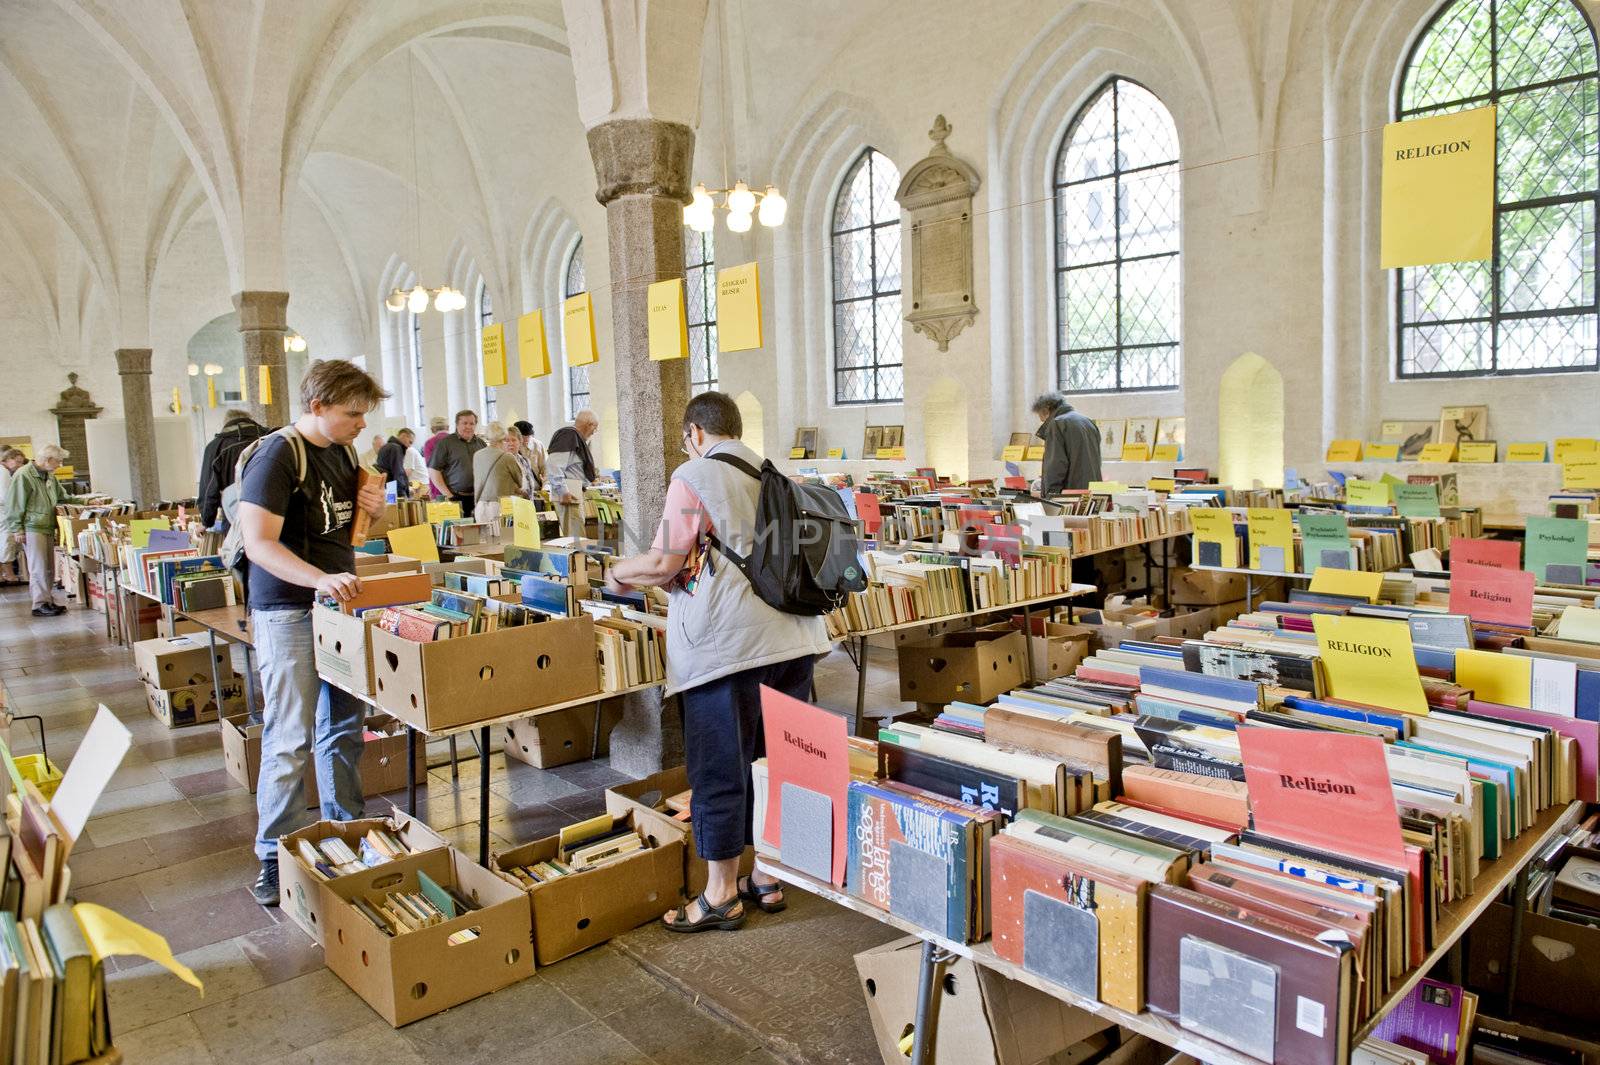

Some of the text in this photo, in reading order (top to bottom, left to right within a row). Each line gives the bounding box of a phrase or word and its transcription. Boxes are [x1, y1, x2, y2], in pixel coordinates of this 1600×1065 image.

[1395, 140, 1471, 161] RELIGION
[1538, 533, 1576, 544] Psykologi
[1469, 589, 1512, 604] Religion
[1327, 639, 1392, 658] RELIGION
[783, 730, 828, 761] Religion
[1279, 774, 1357, 795] Religion
[856, 803, 874, 869] søgen
[868, 846, 891, 903] lange
